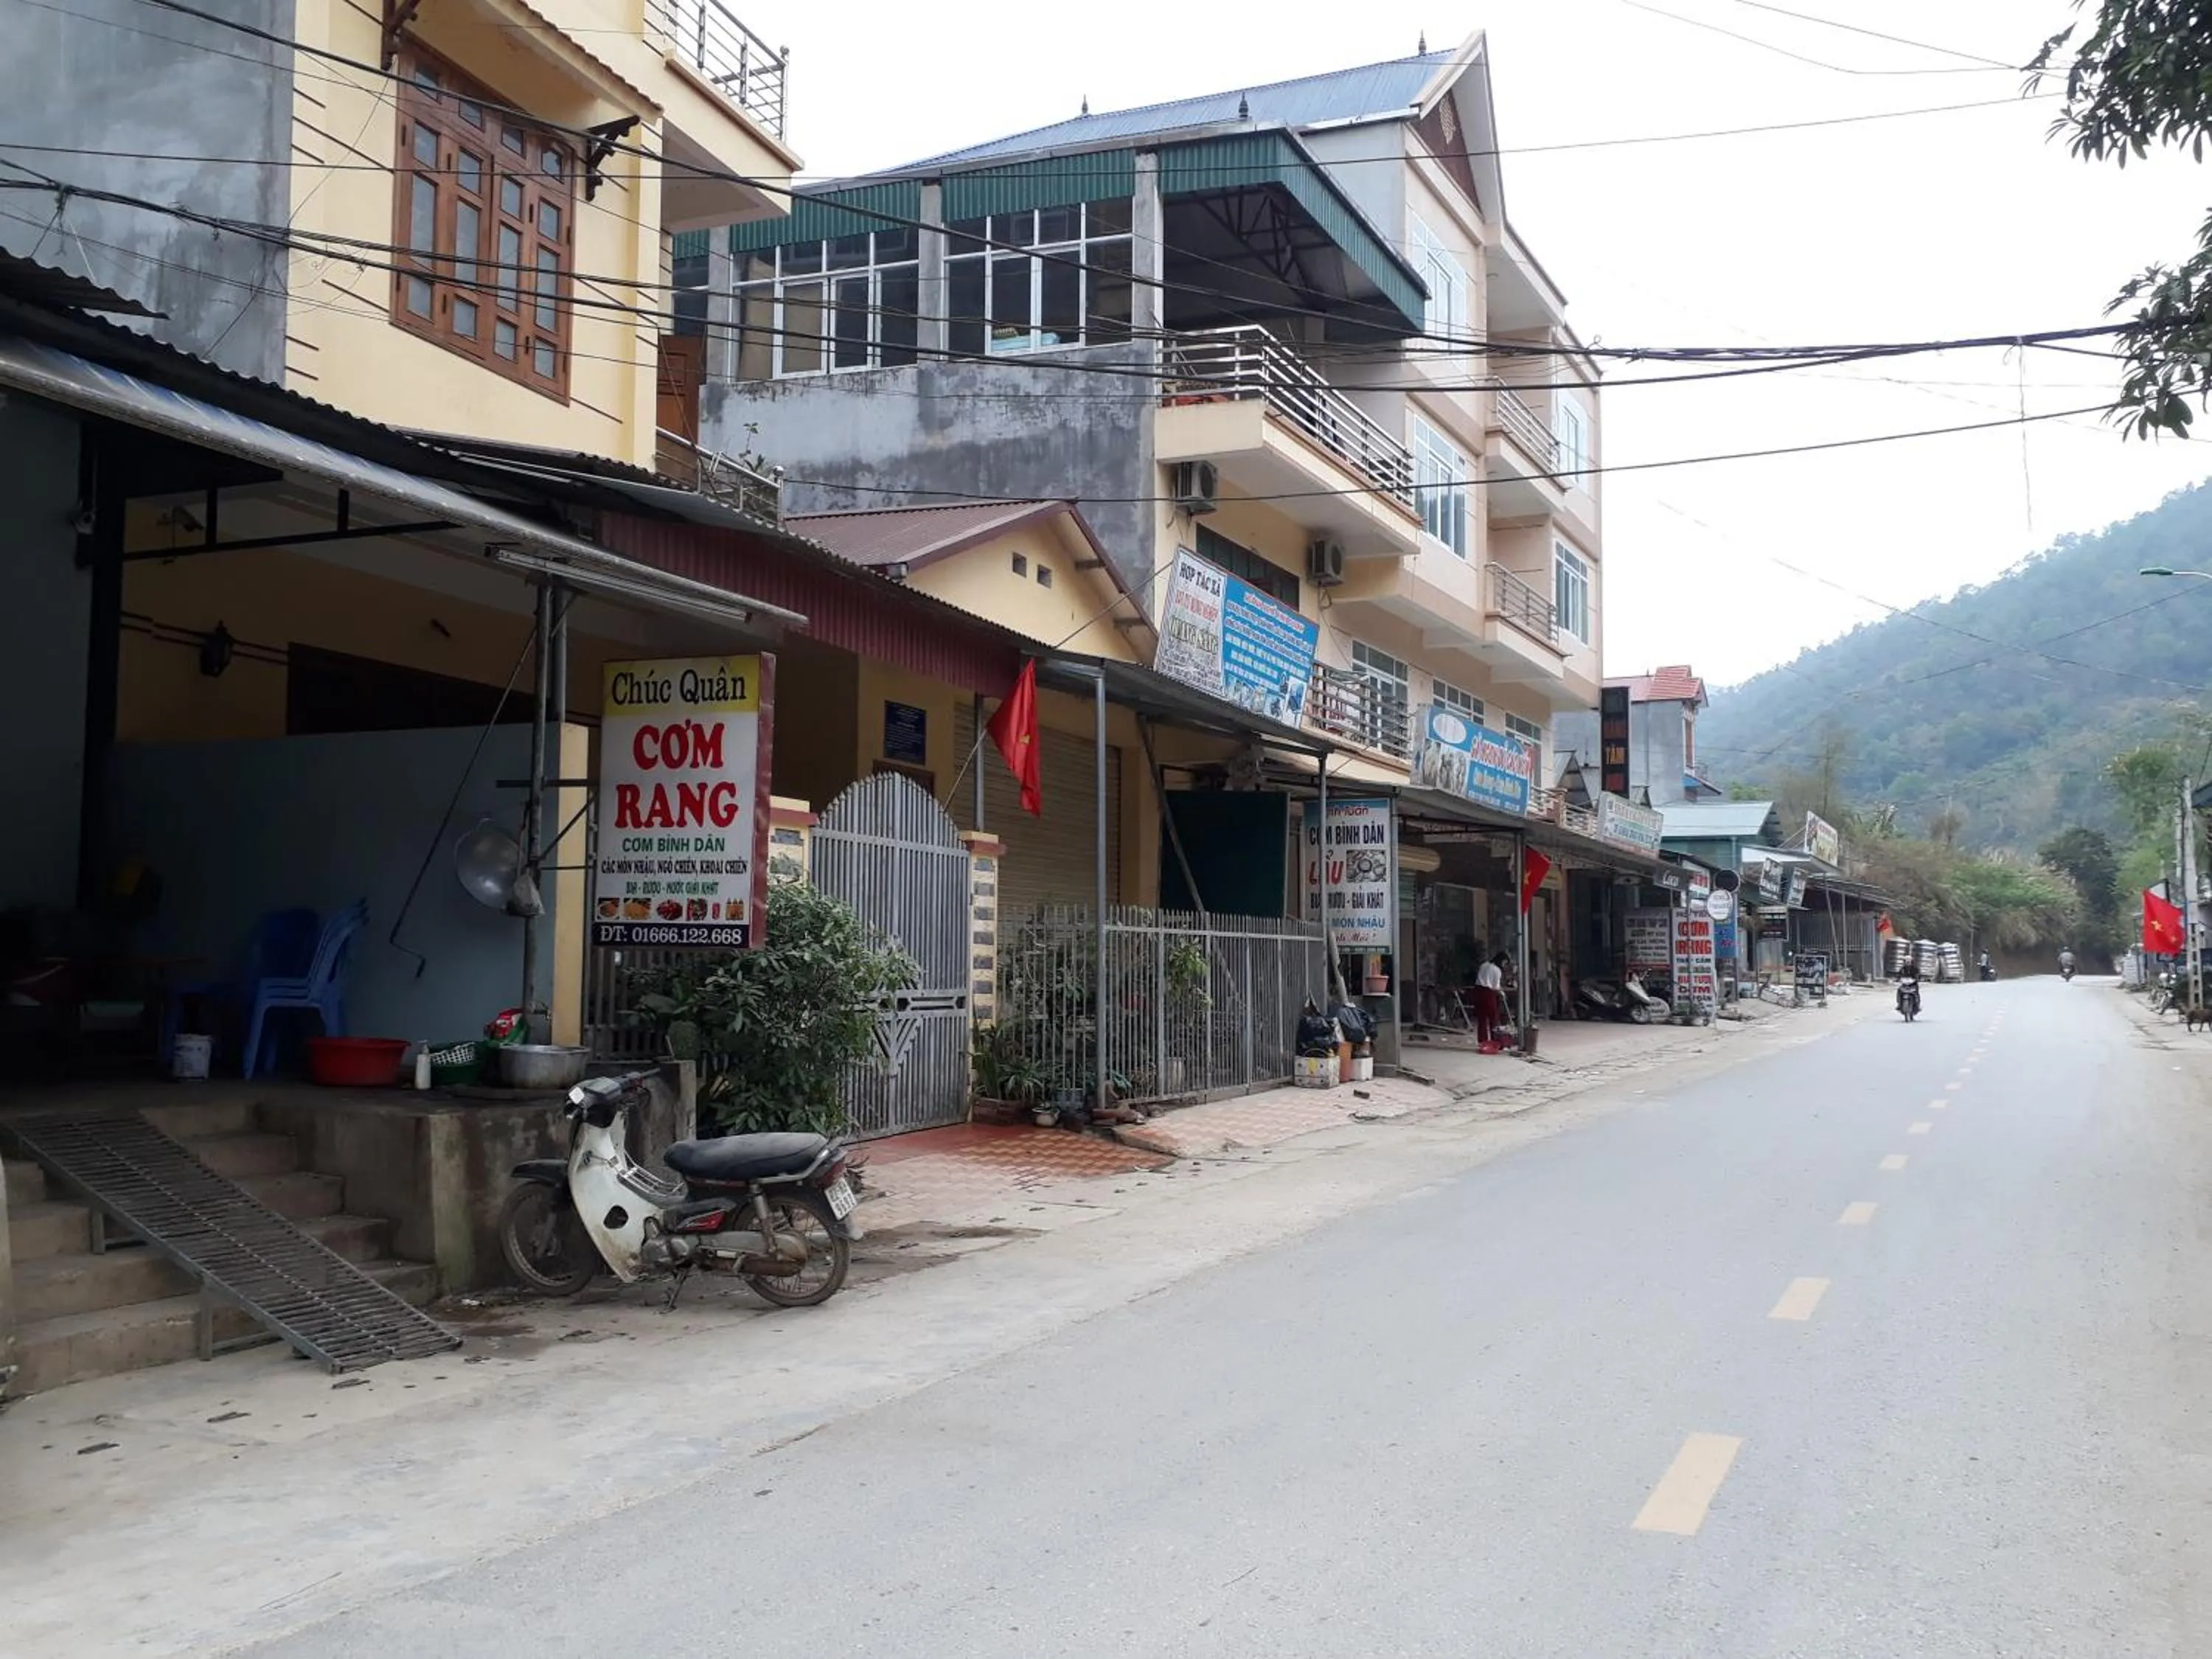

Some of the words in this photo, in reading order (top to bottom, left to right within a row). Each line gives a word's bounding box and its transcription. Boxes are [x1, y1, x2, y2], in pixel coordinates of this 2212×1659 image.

[612, 669, 671, 706] Chúc
[680, 667, 746, 704] Quân
[633, 719, 725, 771] CƠM
[615, 782, 739, 830] RANG
[622, 837, 653, 852] CƠM
[658, 834, 689, 852] BÌNH
[695, 835, 725, 852] DÂN
[1335, 821, 1360, 845] BÌNH
[1363, 820, 1385, 844] DÂN
[602, 858, 615, 874] CÁC
[600, 925, 627, 942] ĐT:
[632, 926, 742, 945] 01666.122.668
